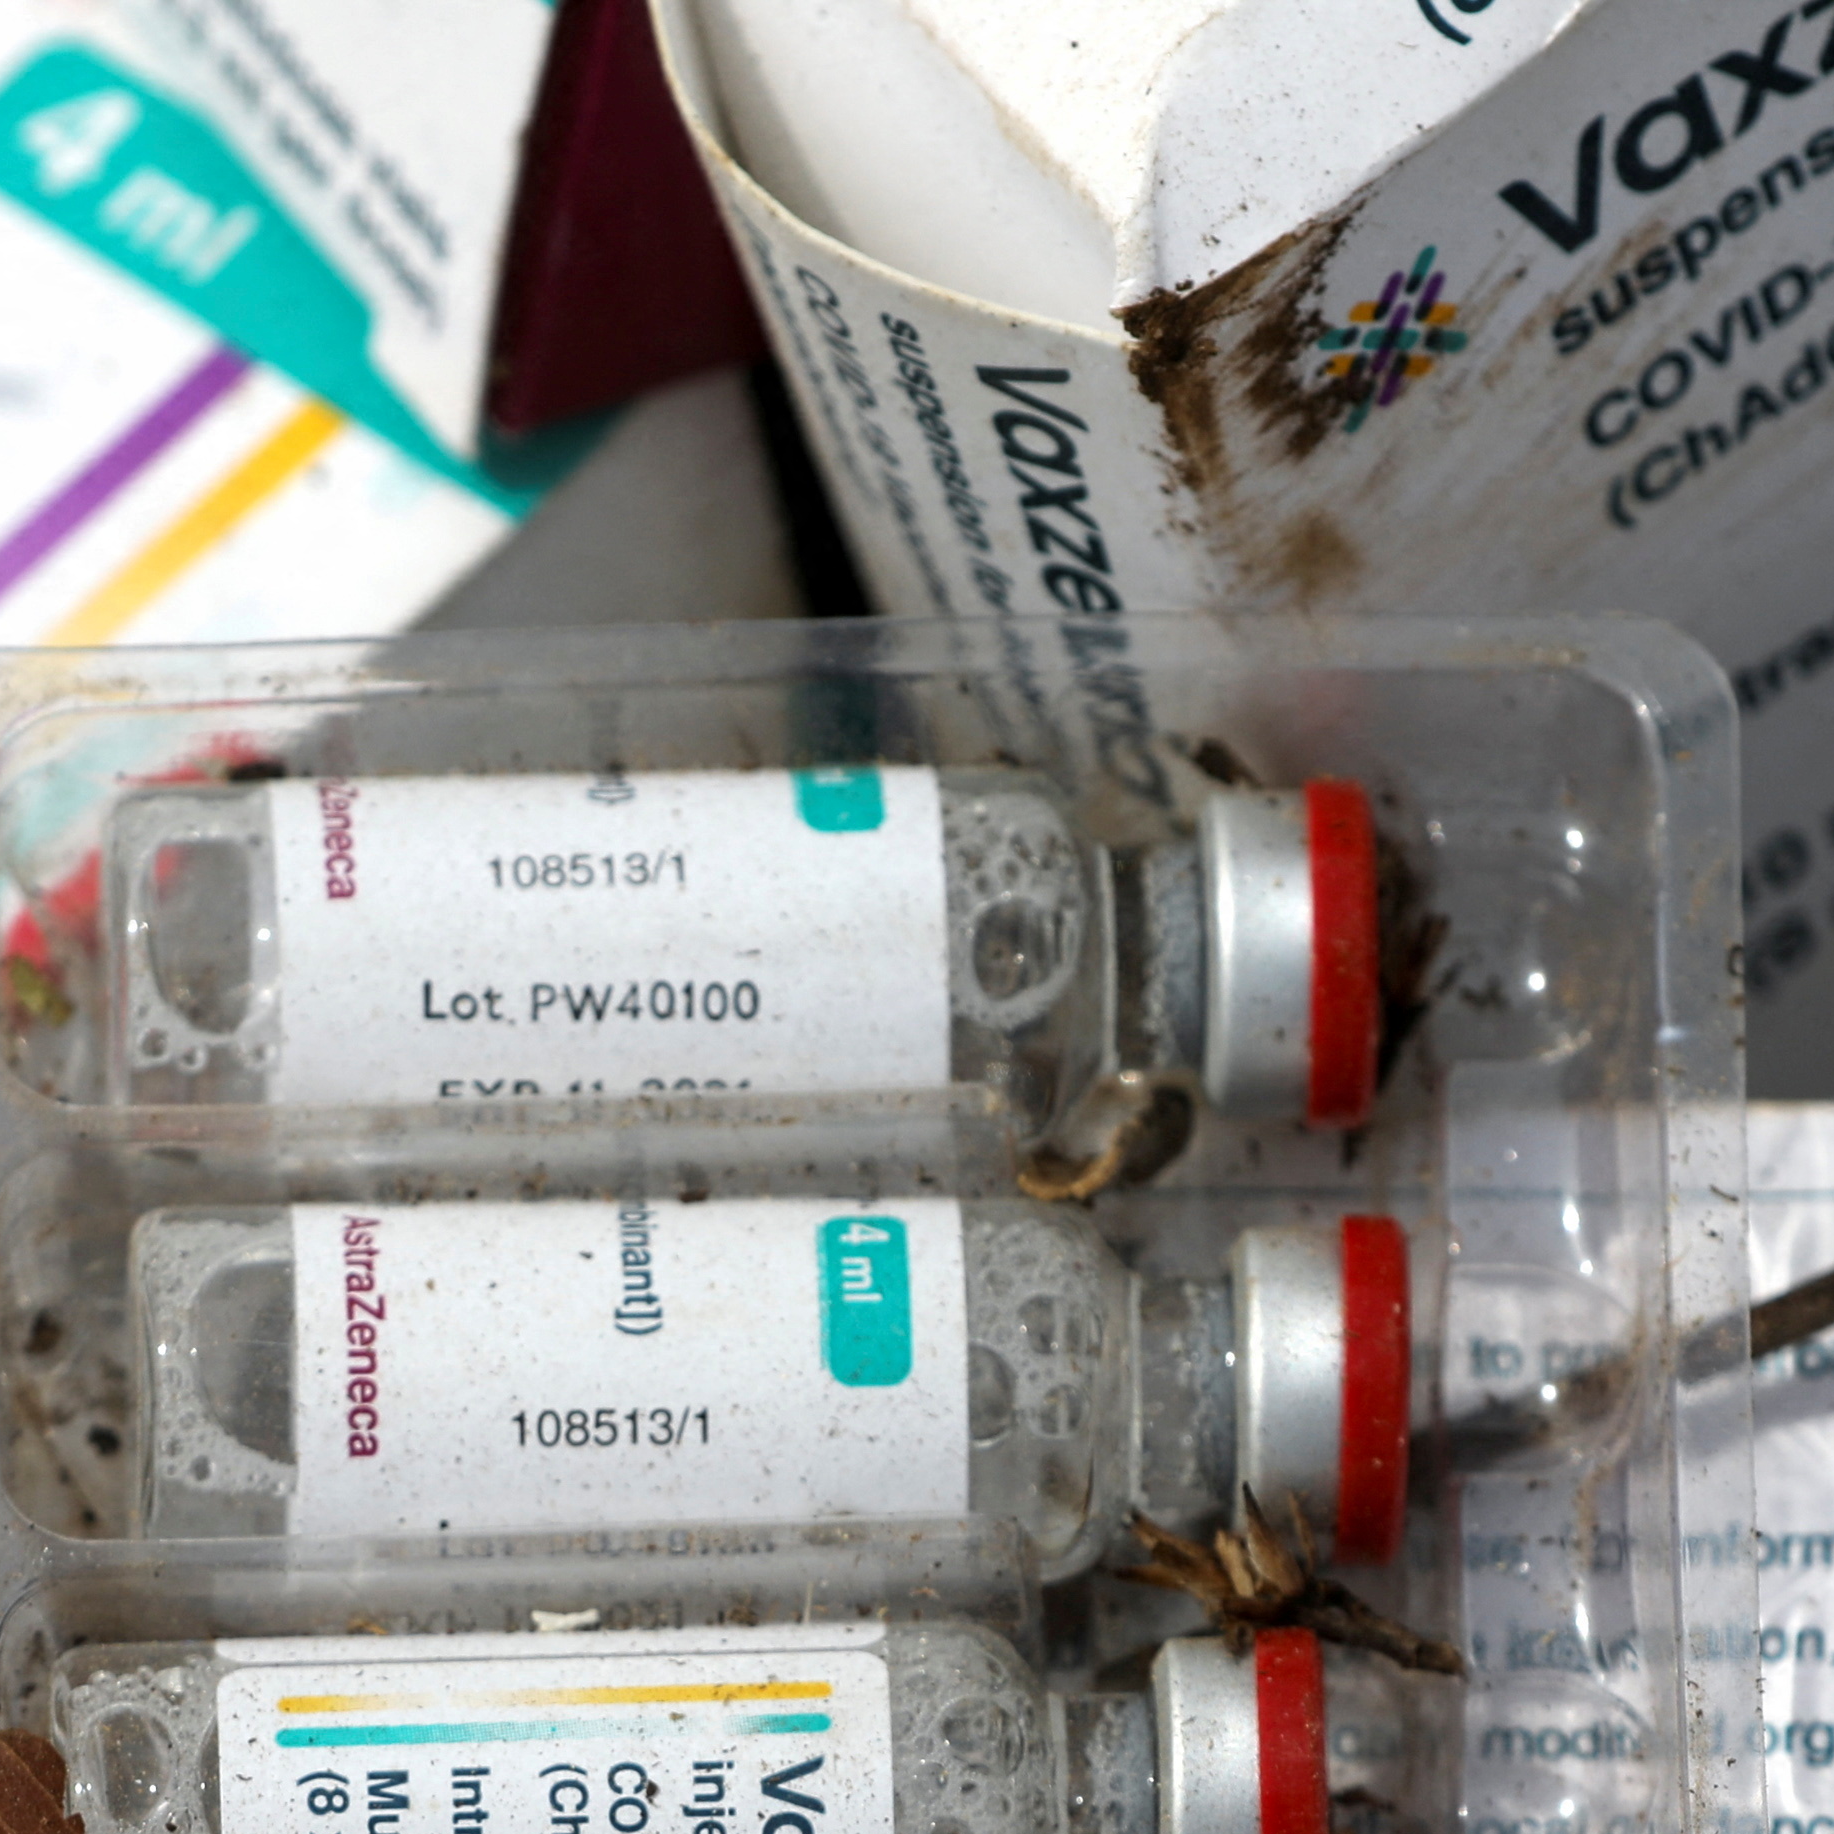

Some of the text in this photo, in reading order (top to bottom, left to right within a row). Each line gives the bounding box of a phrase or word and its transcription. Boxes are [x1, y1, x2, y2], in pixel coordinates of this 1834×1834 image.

[19, 88, 138, 195] 4
[99, 166, 259, 283] ml
[881, 311, 993, 553] suspension
[487, 853, 689, 890] 108513/1
[531, 979, 760, 1022] PW40100
[614, 1203, 664, 1335] binant])
[838, 1221, 891, 1303] 4 ml
[342, 1214, 386, 1459] AstraZeneca
[510, 1407, 713, 1448] 108513/1
[296, 1770, 350, 1815] (8
